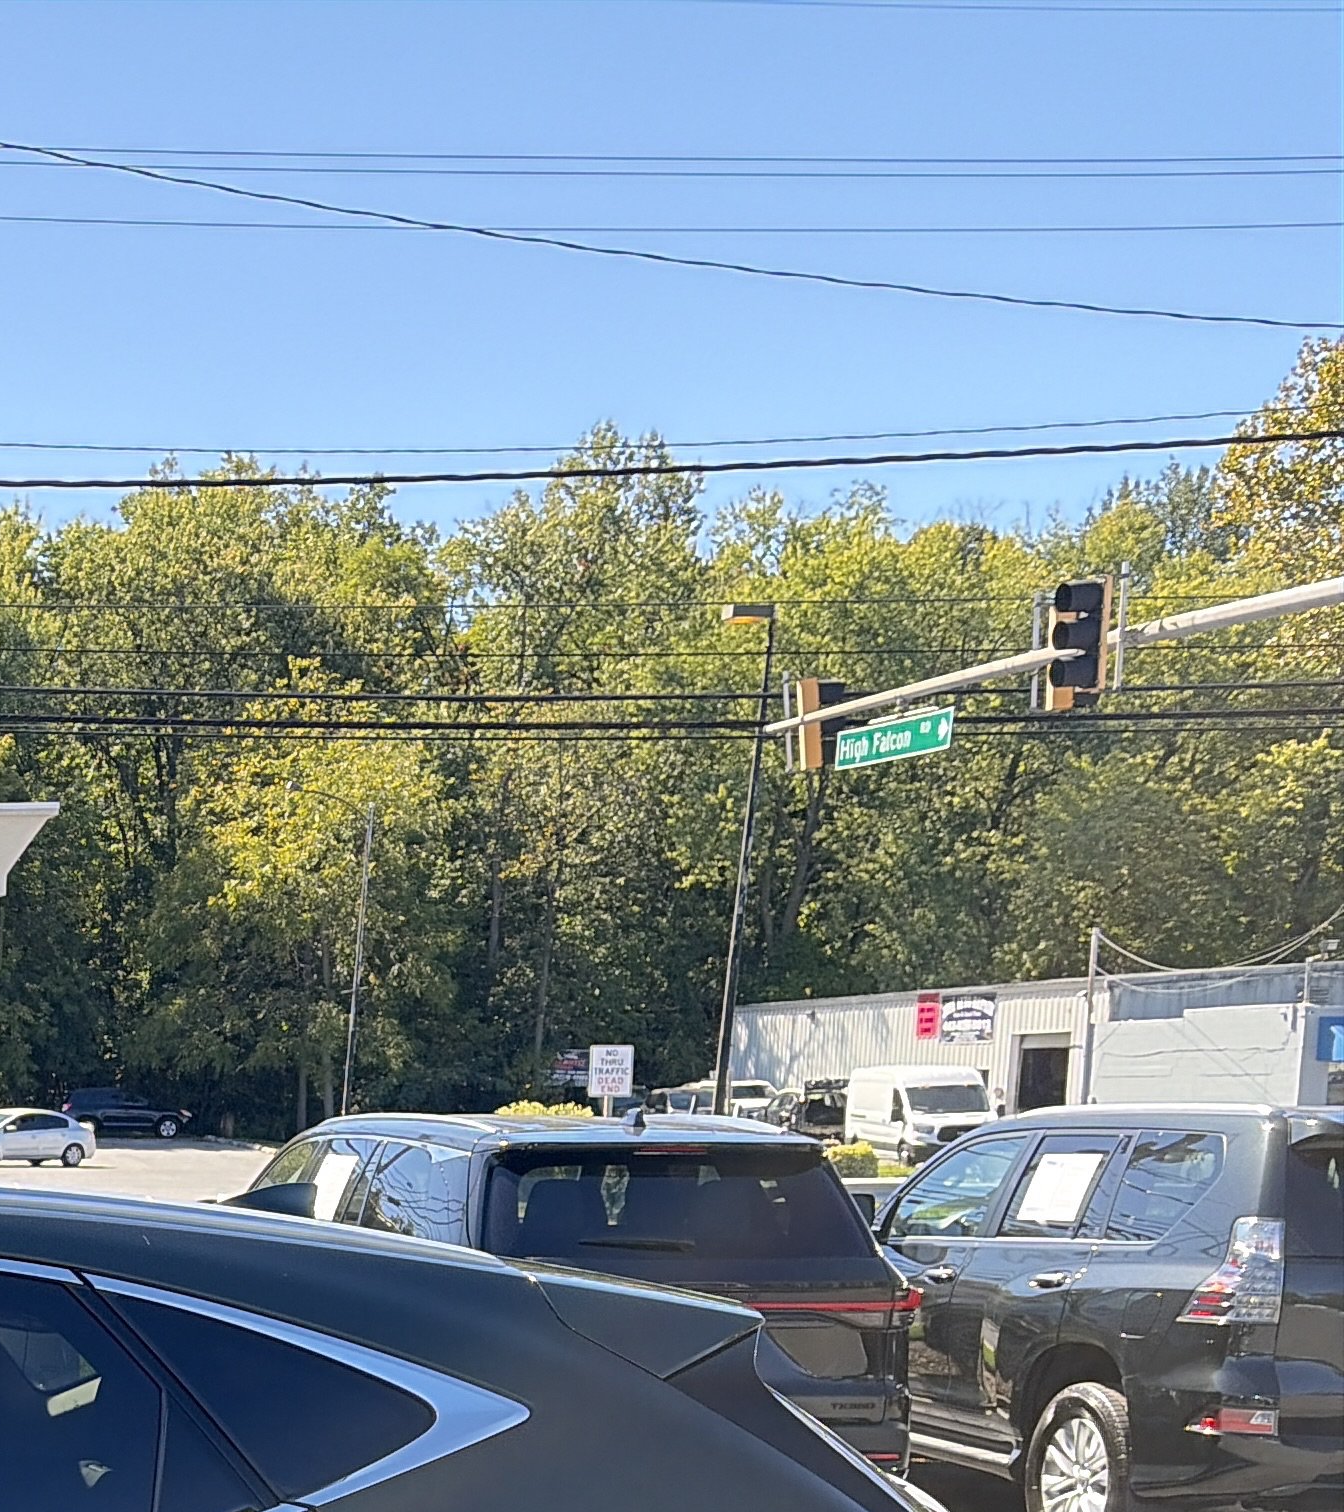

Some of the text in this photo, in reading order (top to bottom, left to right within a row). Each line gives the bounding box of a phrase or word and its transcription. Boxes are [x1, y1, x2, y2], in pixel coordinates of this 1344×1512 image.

[839, 735, 869, 763] High
[872, 729, 912, 755] Falcon
[605, 1049, 619, 1057] NO
[600, 1058, 624, 1066] THRU
[594, 1068, 630, 1076] TRAFFIC
[597, 1077, 624, 1085] DEAD
[601, 1085, 621, 1093] END
